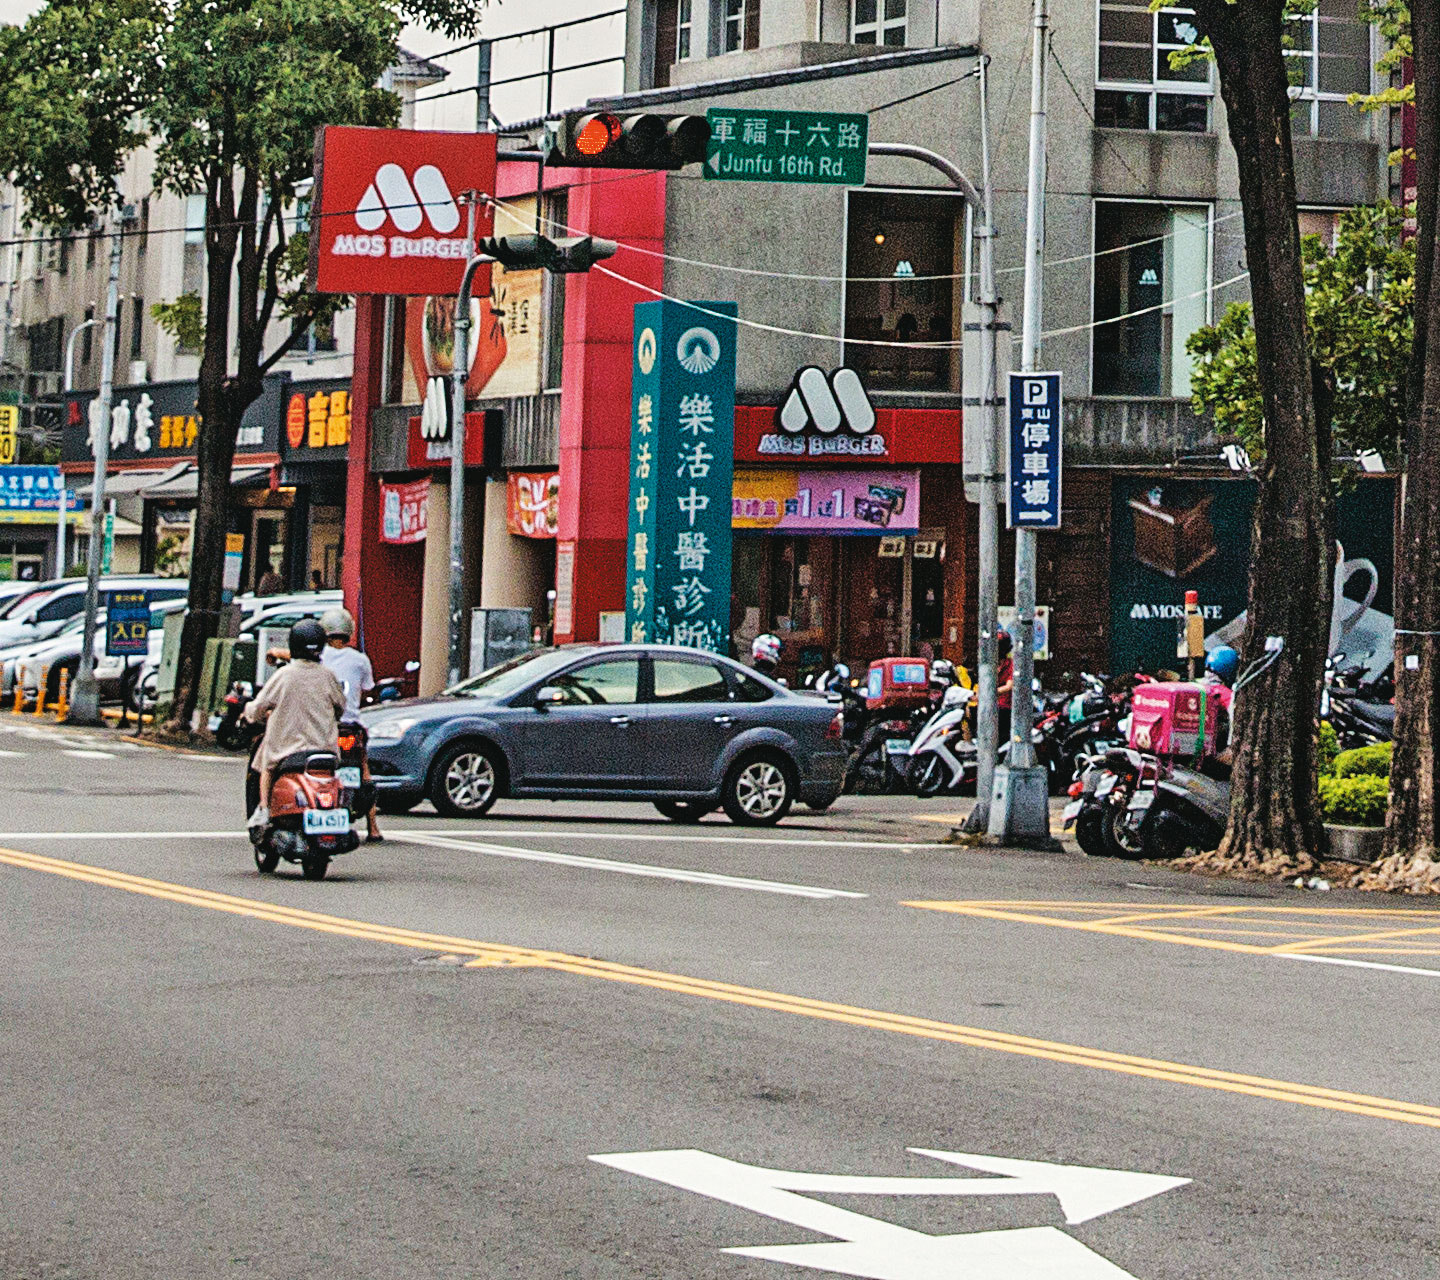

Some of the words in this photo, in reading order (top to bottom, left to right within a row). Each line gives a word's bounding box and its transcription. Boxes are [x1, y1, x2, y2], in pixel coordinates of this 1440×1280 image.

[710, 116, 863, 149] 軍福十六路
[722, 152, 773, 174] Junfu
[778, 154, 814, 175] 16th
[818, 156, 847, 177] Rd.
[331, 234, 387, 257] MOS
[307, 390, 353, 448] 吉品
[757, 434, 806, 455] MOS
[808, 434, 887, 456] BURGER
[1021, 422, 1051, 505] 停車場
[670, 392, 715, 646] 樂活中醫診所
[112, 622, 147, 640] 入口
